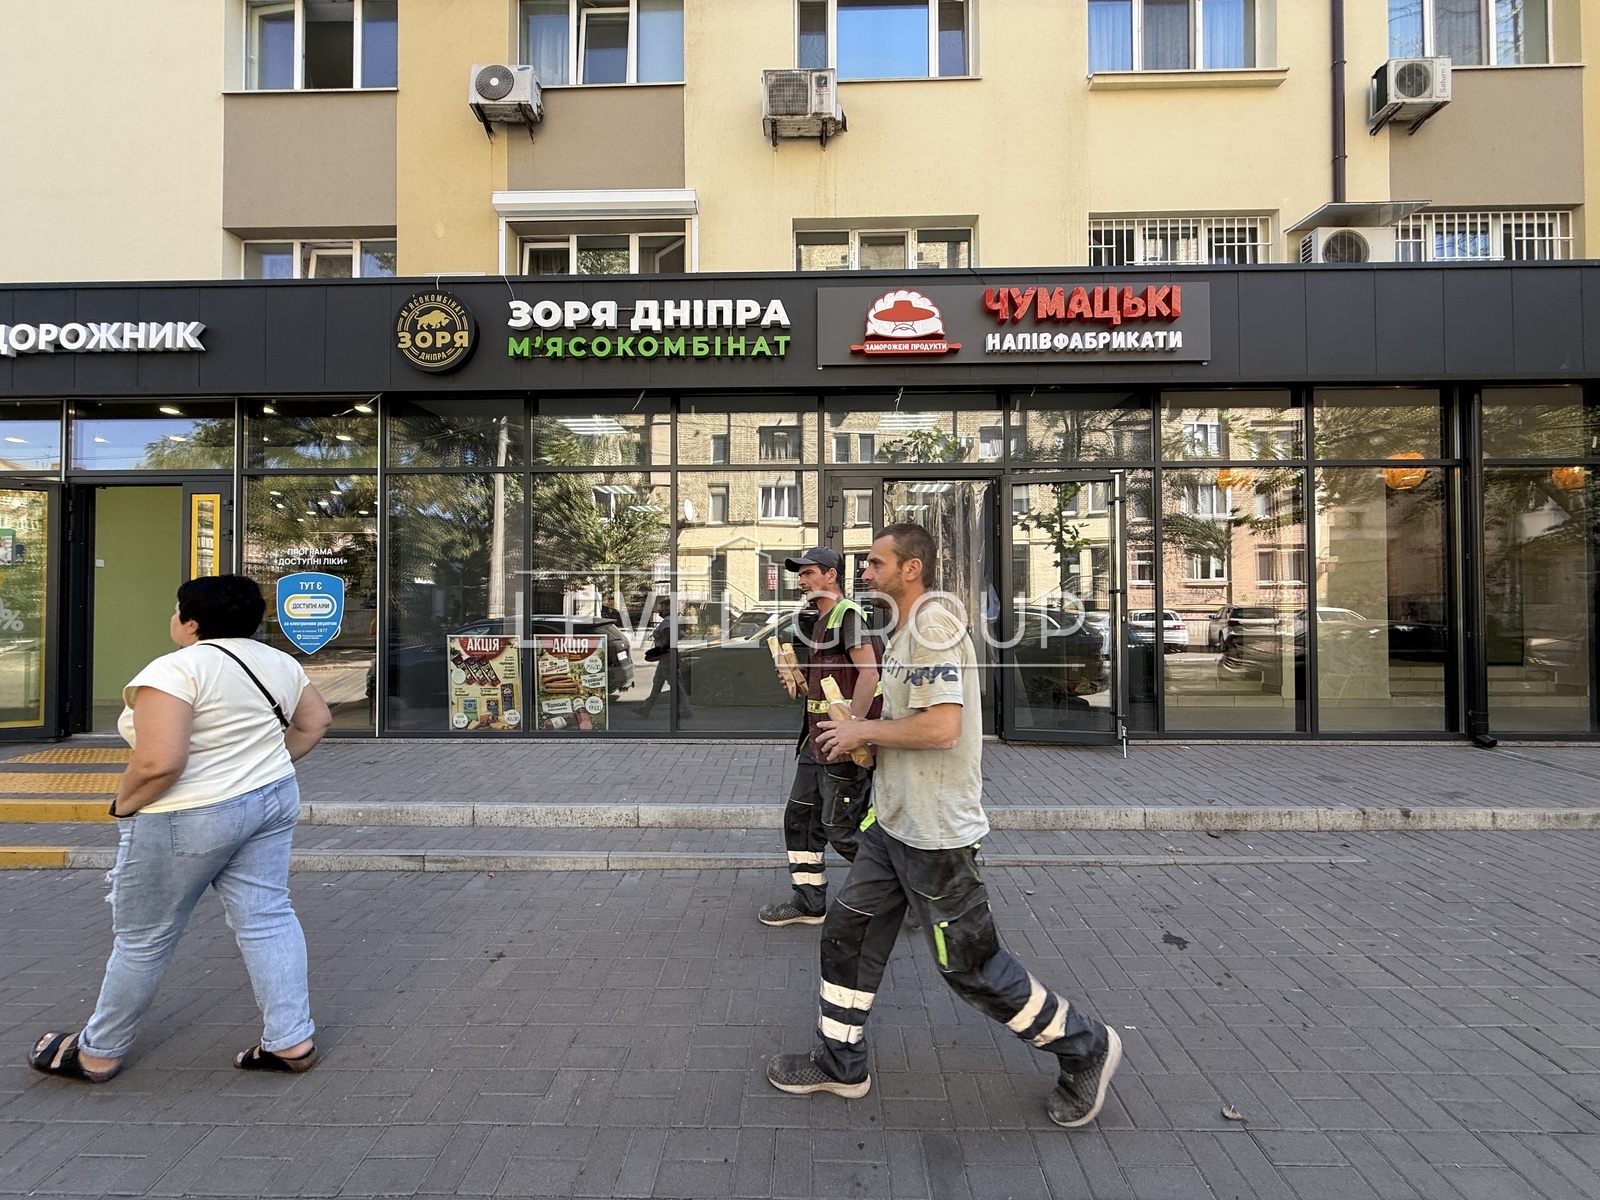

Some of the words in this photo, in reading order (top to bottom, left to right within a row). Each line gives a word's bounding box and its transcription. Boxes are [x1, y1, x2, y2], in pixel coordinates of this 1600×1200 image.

[983, 284, 1183, 329] ЧУМАЦЬКІ
[507, 300, 618, 330] ЗОРЯ
[630, 299, 791, 334] ДНІПРА
[397, 331, 469, 349] ЗОРЯ
[985, 330, 1184, 354] НАПІВФАБРИКАТИ
[865, 343, 910, 351] ЗАМОРОЖЕНІ
[911, 342, 947, 351] ПРОДУКТИ
[418, 351, 447, 361] ДНІПРА
[287, 547, 333, 556] ПРОГРАМА
[274, 557, 322, 566] «ДОСТУПНІ
[323, 557, 348, 566] ЛІКИ»
[299, 581, 316, 591] ТУТ
[316, 581, 323, 591] Є
[292, 602, 317, 610] ДОСТУПНІ
[466, 637, 500, 652] АКЦІЯ
[552, 637, 589, 654] АКЦІЯ
